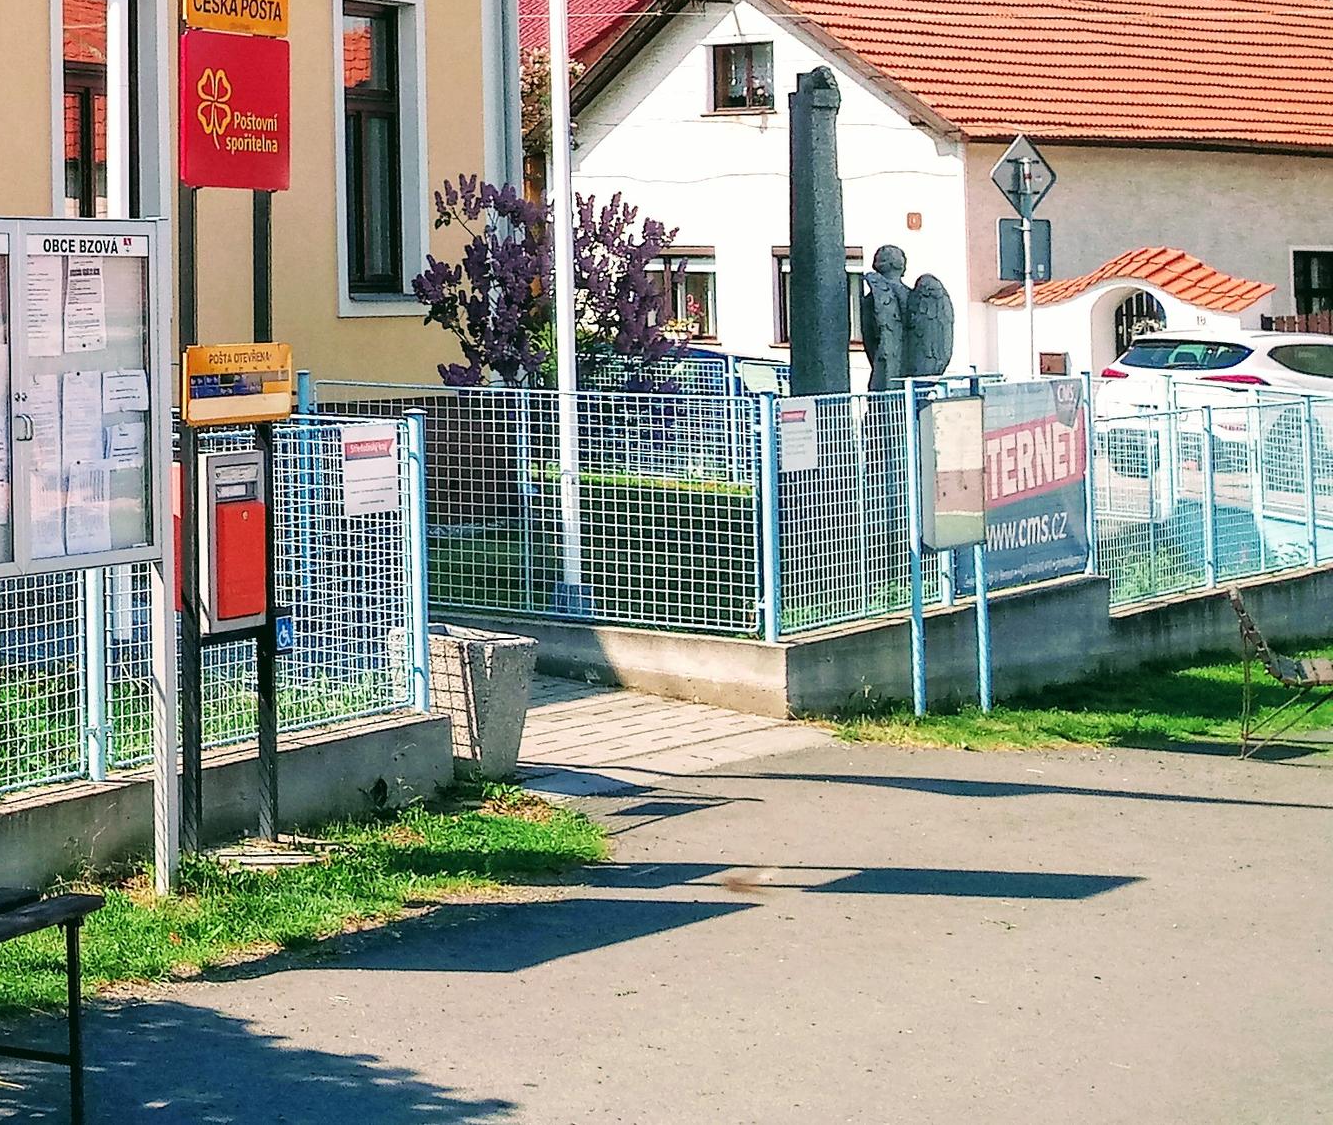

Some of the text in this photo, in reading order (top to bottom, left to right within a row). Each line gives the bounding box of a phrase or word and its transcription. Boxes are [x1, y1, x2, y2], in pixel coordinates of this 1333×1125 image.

[234, 111, 278, 131] Poštovní
[226, 133, 278, 155] spořitelna
[43, 237, 119, 254] OBCE BZOVÁ
[209, 351, 232, 364] POŠTA
